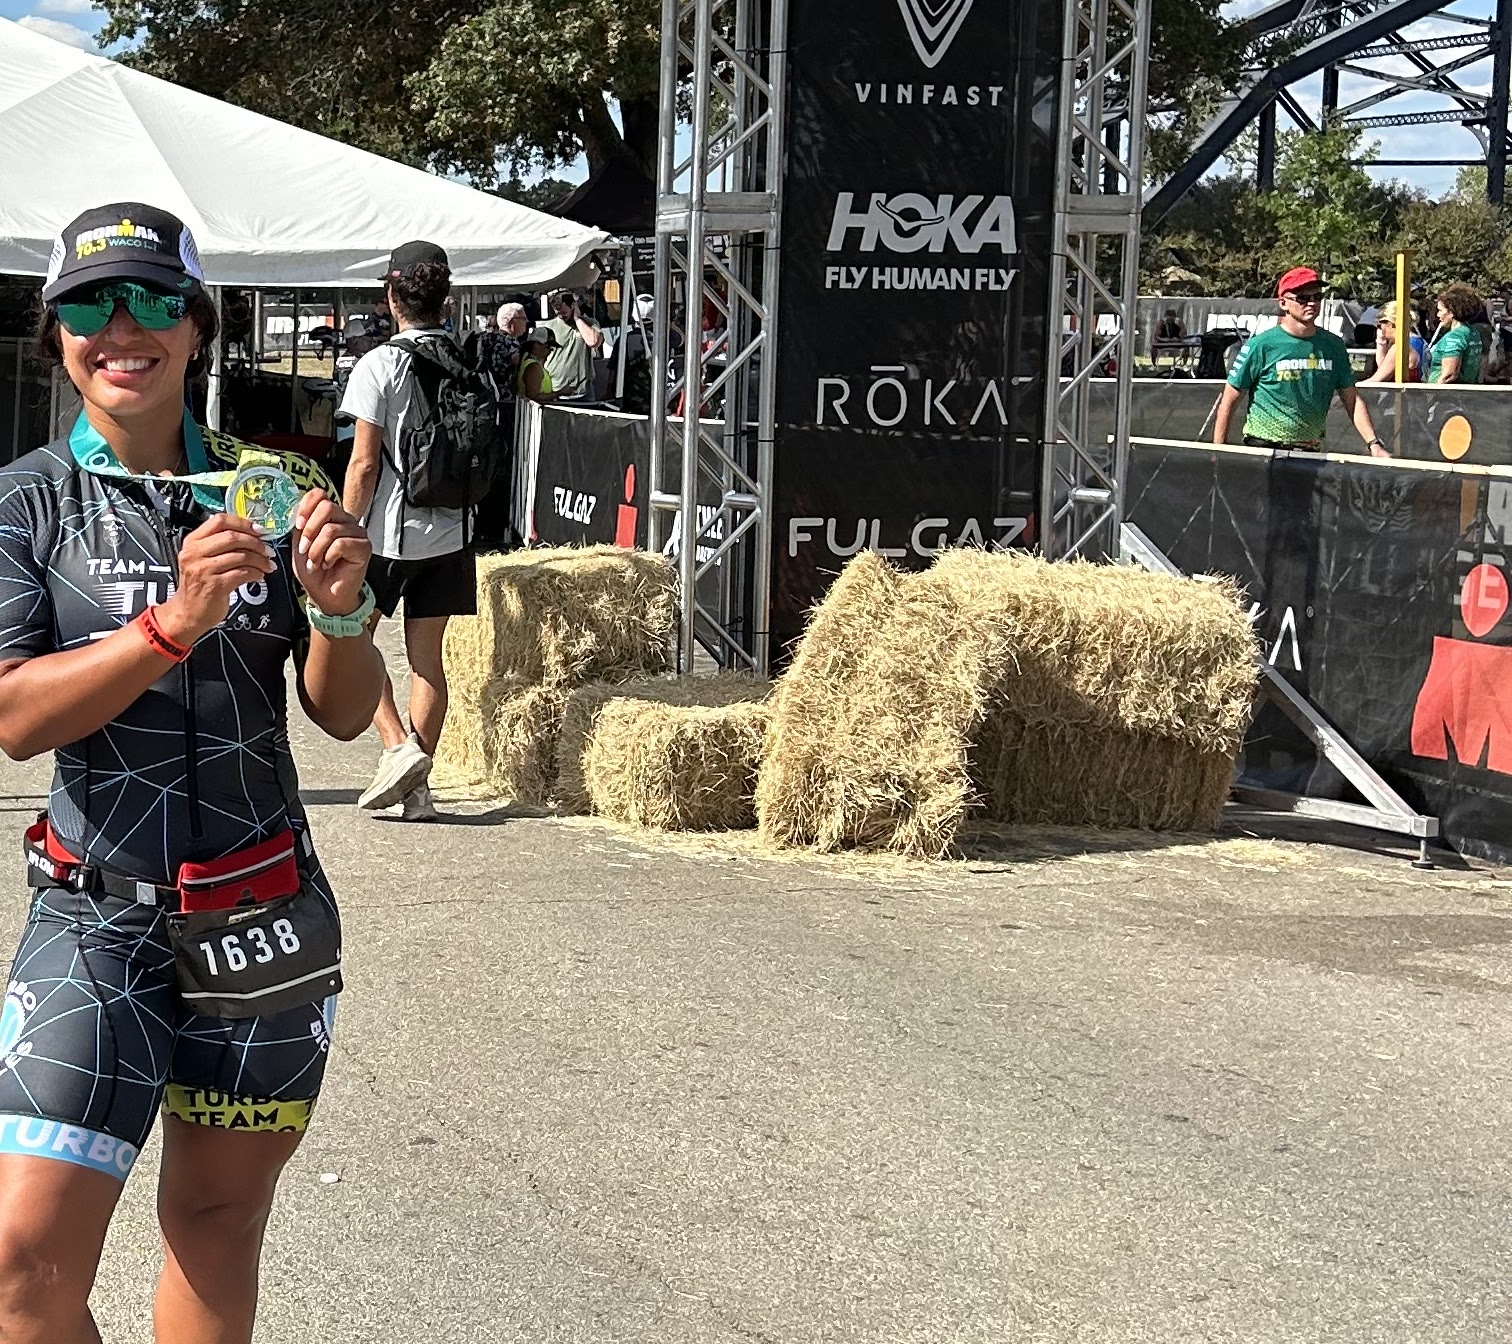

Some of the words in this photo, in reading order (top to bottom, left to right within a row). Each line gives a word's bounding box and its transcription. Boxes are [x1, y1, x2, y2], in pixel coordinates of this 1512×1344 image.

[854, 83, 1004, 106] VINFAST
[76, 218, 160, 246] IRONMAN
[826, 192, 1018, 254] HOKA
[76, 238, 107, 260] 70.3
[108, 237, 142, 248] WACO
[825, 266, 866, 290] FLY
[872, 267, 971, 290] HUMAN
[975, 268, 1016, 291] FLY
[789, 517, 1028, 557] FULGAZ
[87, 558, 146, 575] TEAM
[93, 578, 269, 615] TUO
[199, 918, 301, 976] 1638
[189, 1107, 279, 1129] TEAM
